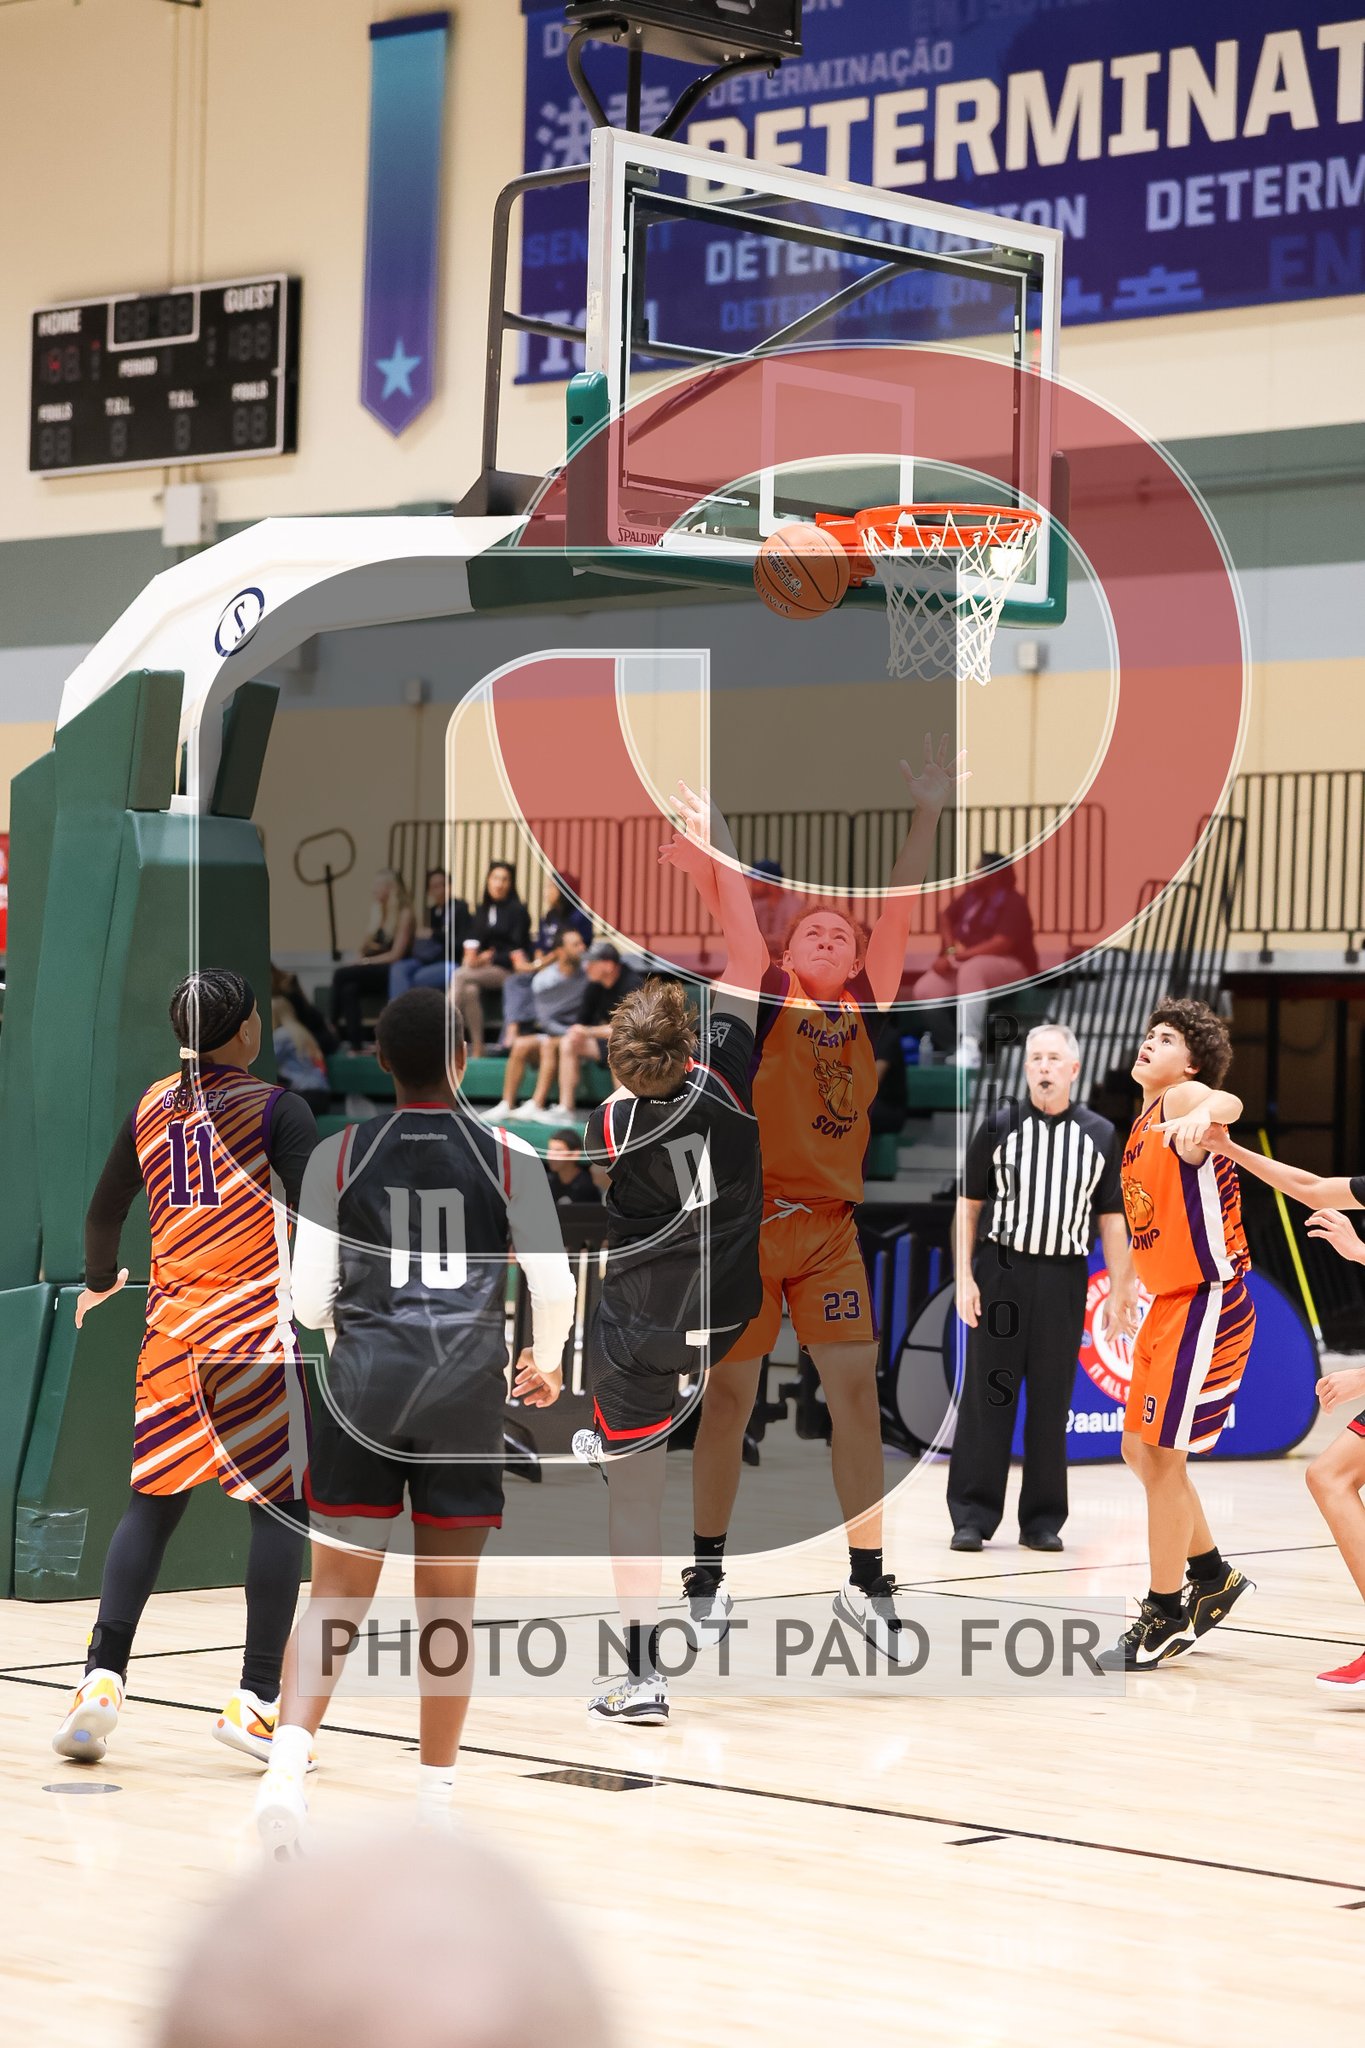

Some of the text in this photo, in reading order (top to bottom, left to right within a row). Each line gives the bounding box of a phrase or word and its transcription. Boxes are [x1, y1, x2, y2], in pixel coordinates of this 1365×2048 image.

[686, 18, 1365, 203] DETERMINAT
[1146, 156, 1365, 232] DETERM
[617, 527, 664, 548] SPALDING
[166, 1120, 222, 1208] 11
[383, 1186, 468, 1290] 10
[823, 1289, 861, 1322] 23
